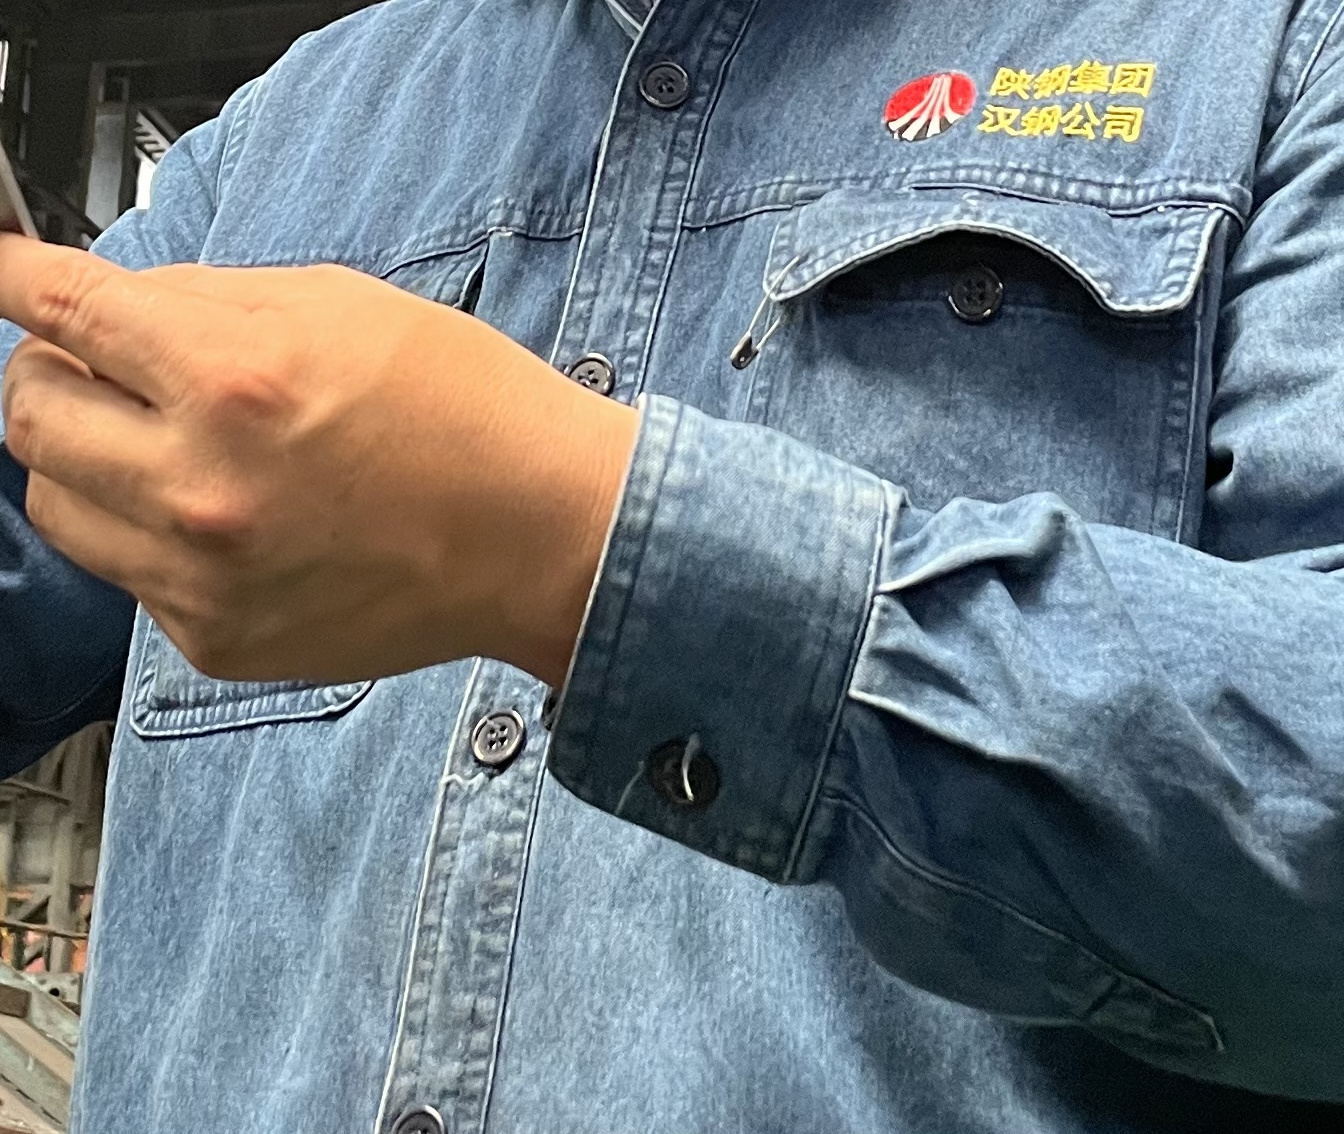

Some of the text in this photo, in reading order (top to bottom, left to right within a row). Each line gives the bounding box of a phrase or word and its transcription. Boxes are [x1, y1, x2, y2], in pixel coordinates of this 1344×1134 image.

[989, 60, 1155, 100] 陕钢集团
[977, 101, 1145, 142] 汉钢公司
